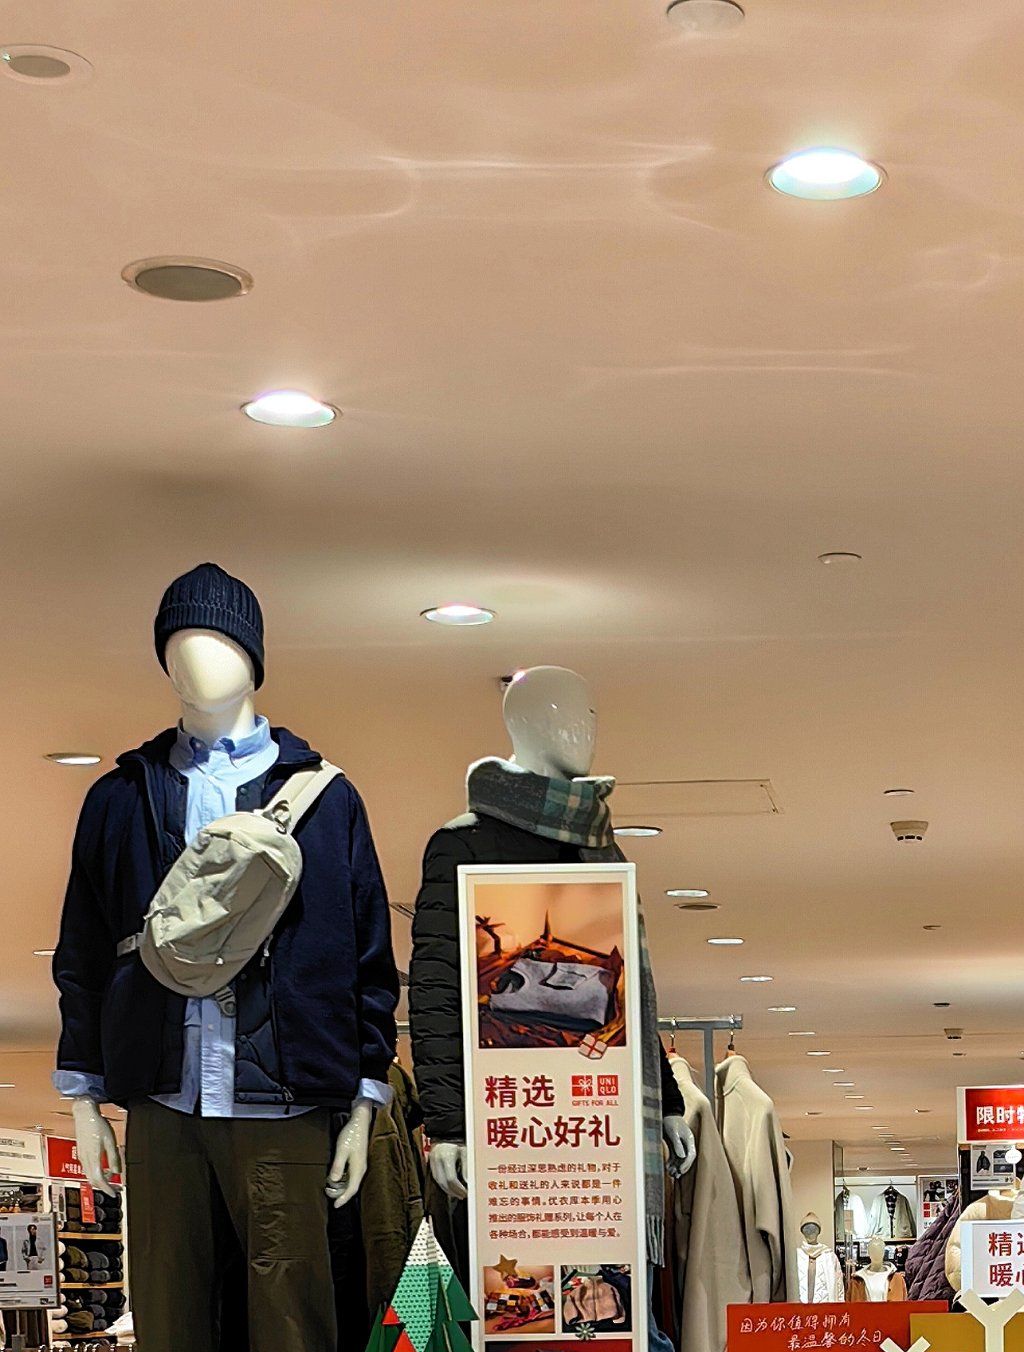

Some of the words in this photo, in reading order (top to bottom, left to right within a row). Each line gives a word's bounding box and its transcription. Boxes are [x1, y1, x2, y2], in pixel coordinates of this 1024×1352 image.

[485, 1075, 555, 1108] 精选
[487, 1115, 620, 1148] 暖心好礼
